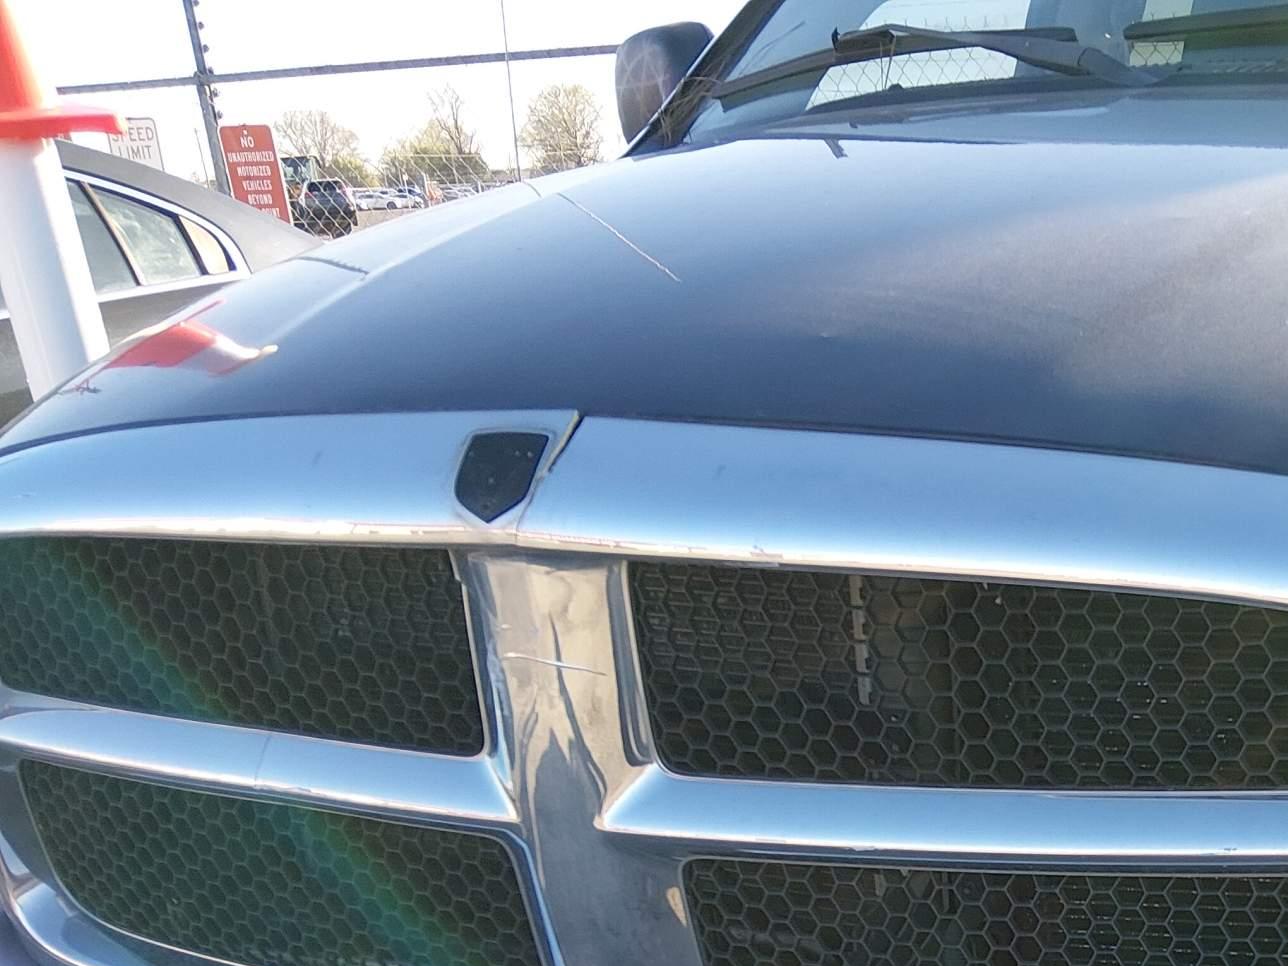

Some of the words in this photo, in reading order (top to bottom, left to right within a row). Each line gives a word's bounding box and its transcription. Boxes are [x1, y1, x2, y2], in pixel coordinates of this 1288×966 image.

[240, 136, 255, 148] NO
[227, 151, 274, 162] UNAUTHORIZED
[236, 165, 272, 176] MOTORIZED
[242, 180, 272, 190] VEHICLES
[247, 194, 272, 205] BEYOND
